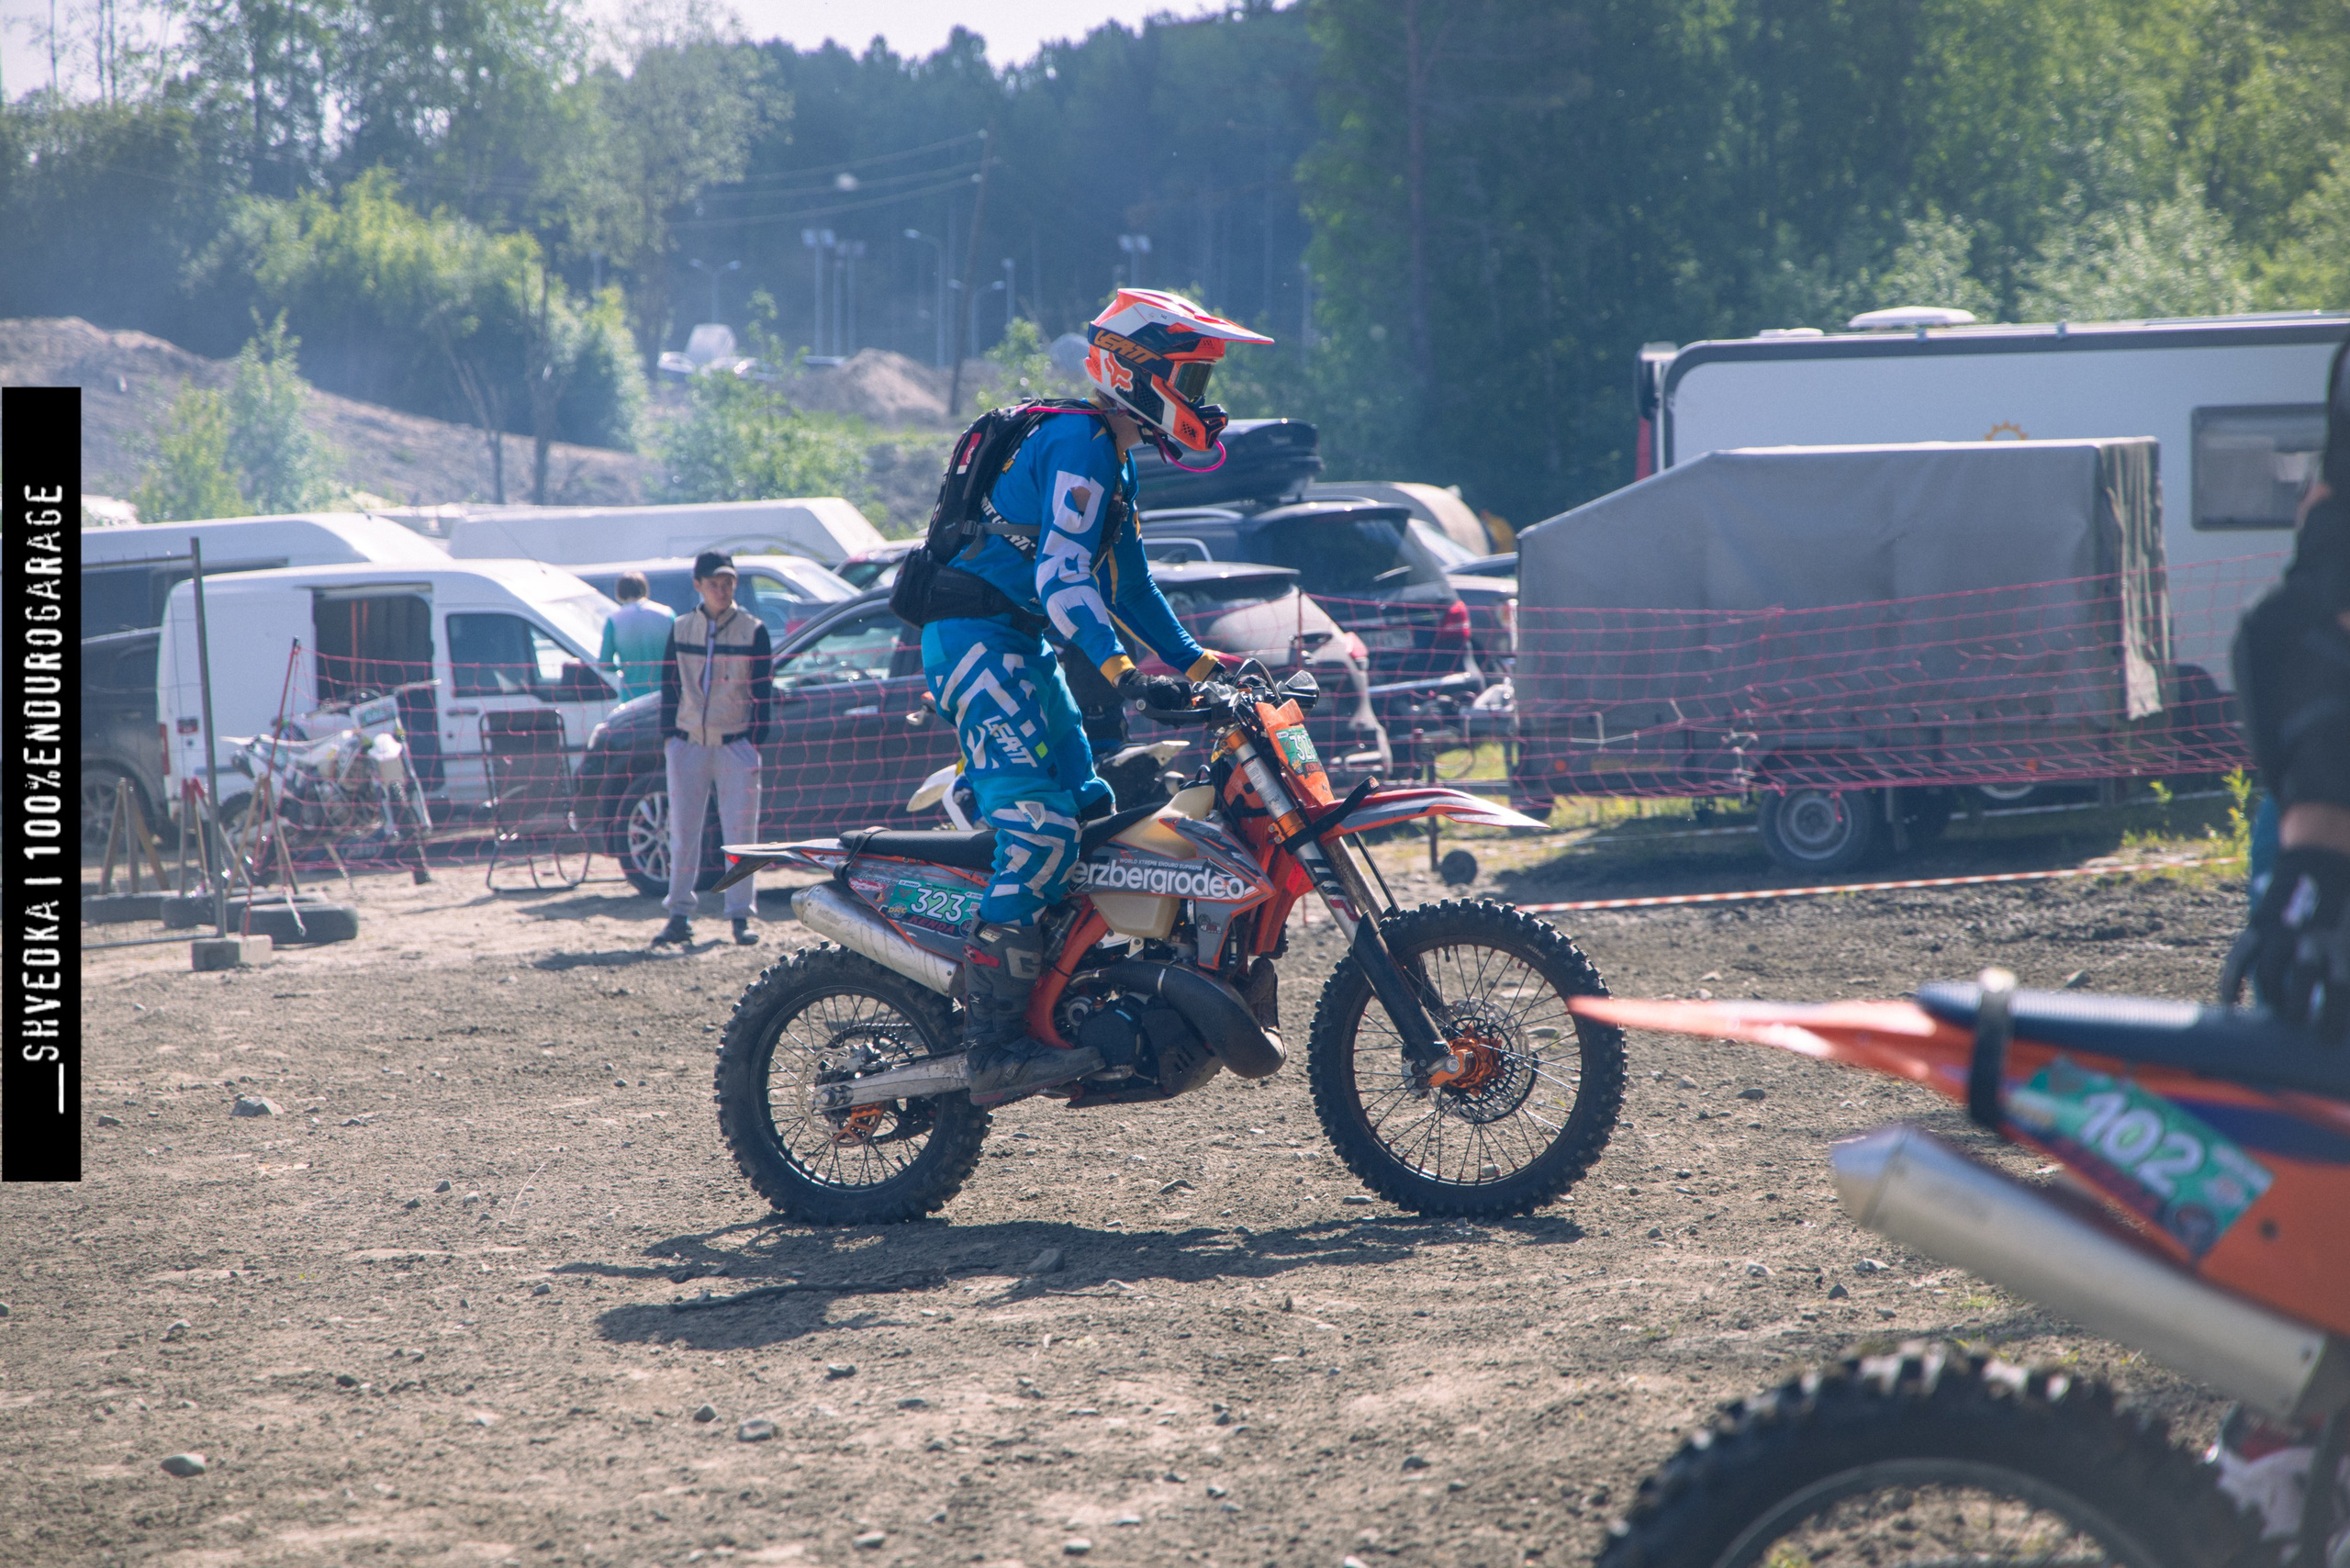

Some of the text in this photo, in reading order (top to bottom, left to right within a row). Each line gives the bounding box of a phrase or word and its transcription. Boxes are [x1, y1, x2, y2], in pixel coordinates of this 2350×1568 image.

[1094, 330, 1162, 364] LEATT
[982, 715, 1038, 768] LEATT
[1070, 859, 1245, 900] erzbergrodeo
[1119, 857, 1138, 866] WORLD
[1179, 863, 1203, 871] SUPREME
[888, 906, 908, 914] DRC
[911, 887, 967, 922] 323
[909, 914, 956, 935] KENDA
[2080, 1092, 2203, 1195] 102
